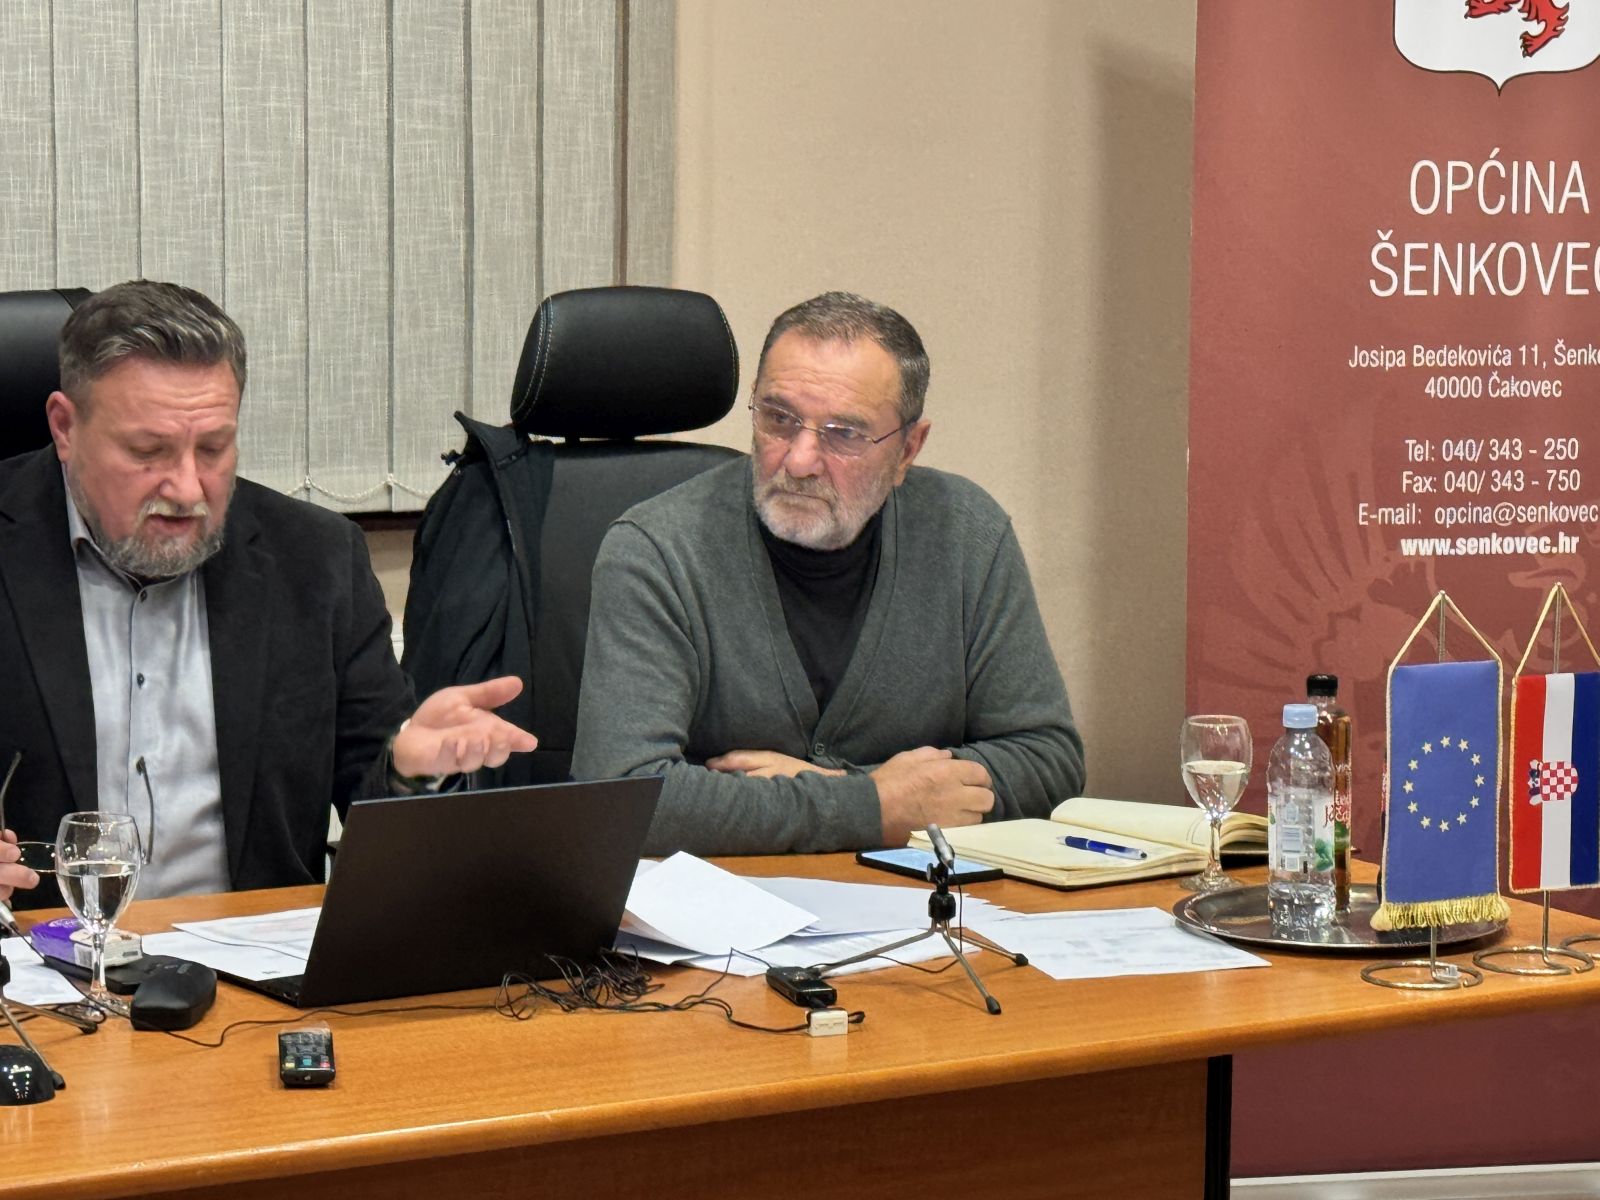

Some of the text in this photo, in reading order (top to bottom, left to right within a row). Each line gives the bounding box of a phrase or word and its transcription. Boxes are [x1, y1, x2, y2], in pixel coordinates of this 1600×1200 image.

[1409, 147, 1590, 216] OPĆINA
[1369, 229, 1600, 298] ŠENKOVE
[1348, 344, 1406, 372] Josipa
[1412, 343, 1512, 372] Bedekovića
[1518, 343, 1547, 370] 11,
[1424, 370, 1563, 399] 40000 Čakovec
[1404, 439, 1435, 463] Tel:
[1441, 438, 1485, 464] 040/
[1488, 437, 1523, 461] 343
[1543, 437, 1579, 461] 250
[1402, 470, 1437, 494] Fax:
[1444, 469, 1486, 495] 040/
[1490, 469, 1525, 493] 343
[1546, 468, 1581, 492] 750
[1358, 500, 1599, 529] E-mail: opcina@senkovec
[1400, 531, 1580, 557] www.senkovec.hr
